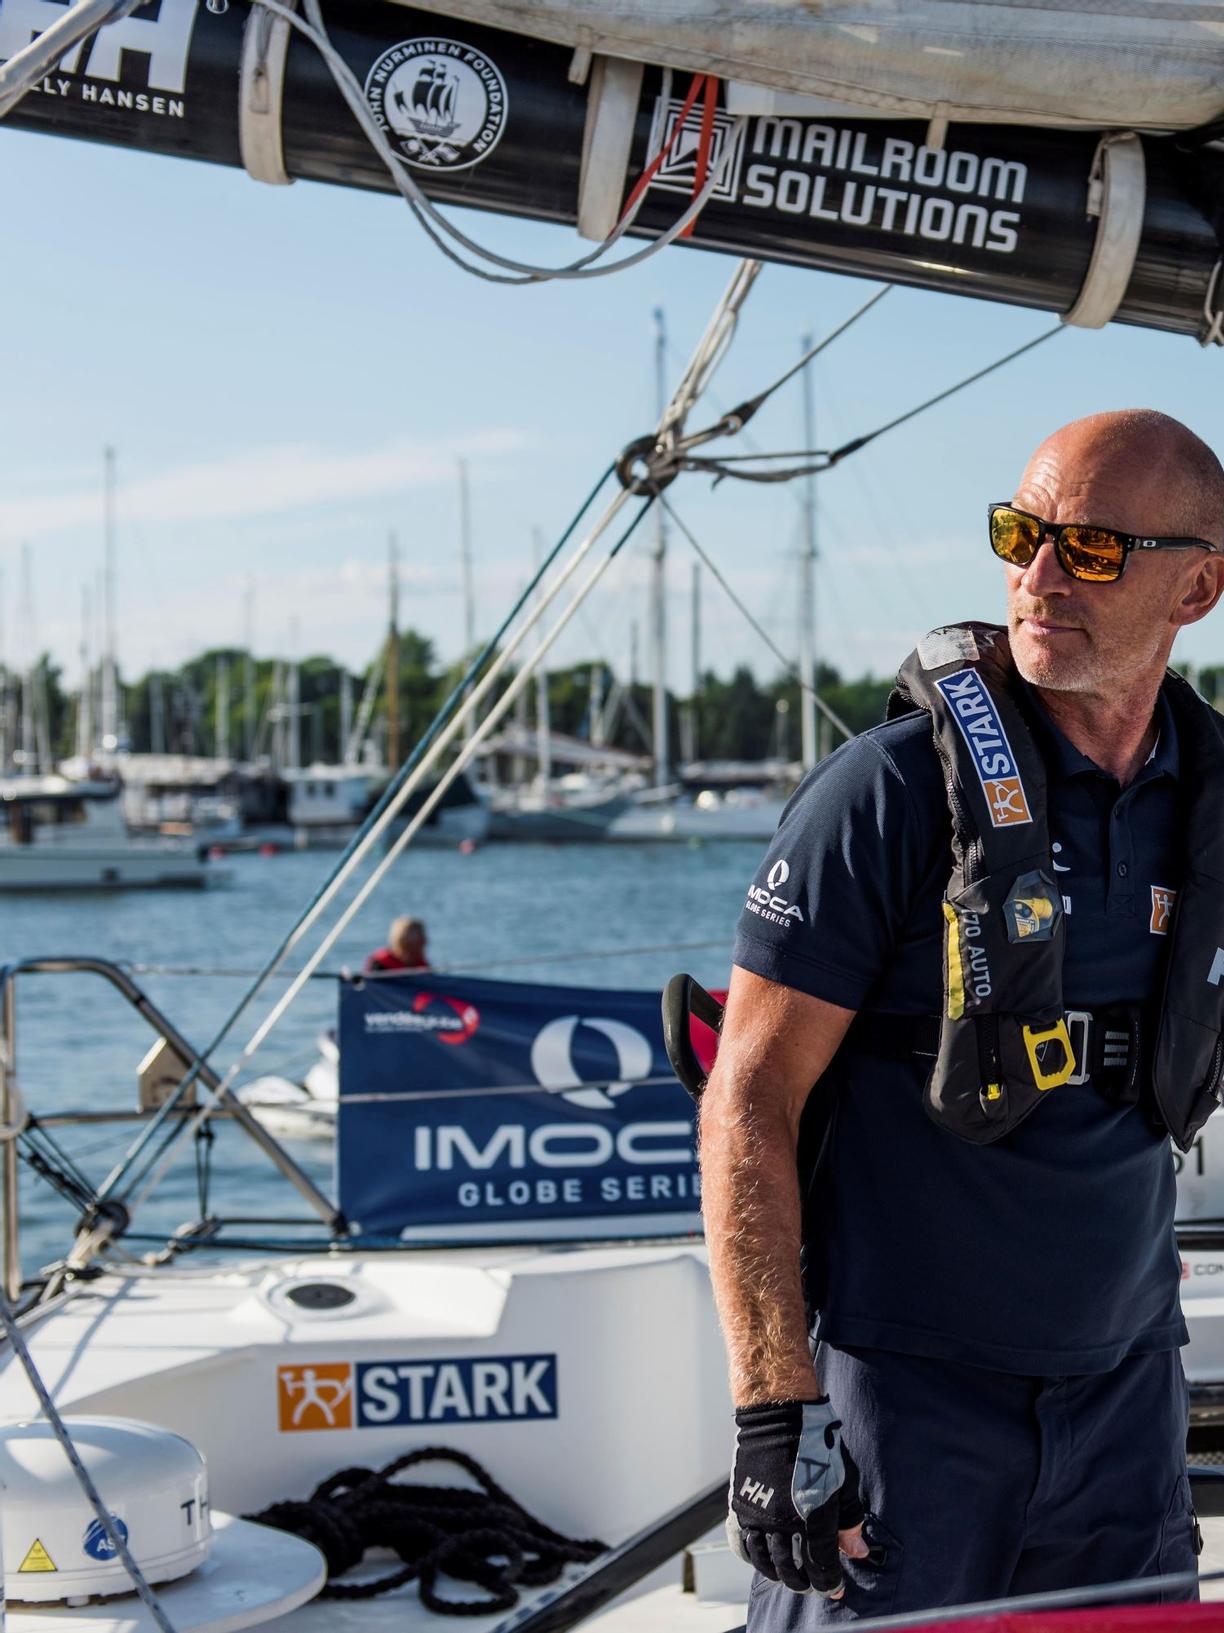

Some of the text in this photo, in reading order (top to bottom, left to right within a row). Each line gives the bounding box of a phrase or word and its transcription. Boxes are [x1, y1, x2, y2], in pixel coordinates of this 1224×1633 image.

[82, 83, 185, 118] HANSEN
[367, 41, 504, 154] JOHN NURMINEN FOUNDATION
[752, 116, 1028, 203] MAILROOM
[743, 164, 1020, 253] SOLUTIONS
[943, 673, 1011, 775] STARK
[760, 908, 792, 928] SERIES
[968, 945, 992, 998] AUTO
[415, 1121, 695, 1170] IMOC
[458, 1174, 702, 1207] GLOBE SERIE
[362, 1361, 552, 1422] STARK
[740, 1476, 775, 1509] HH
